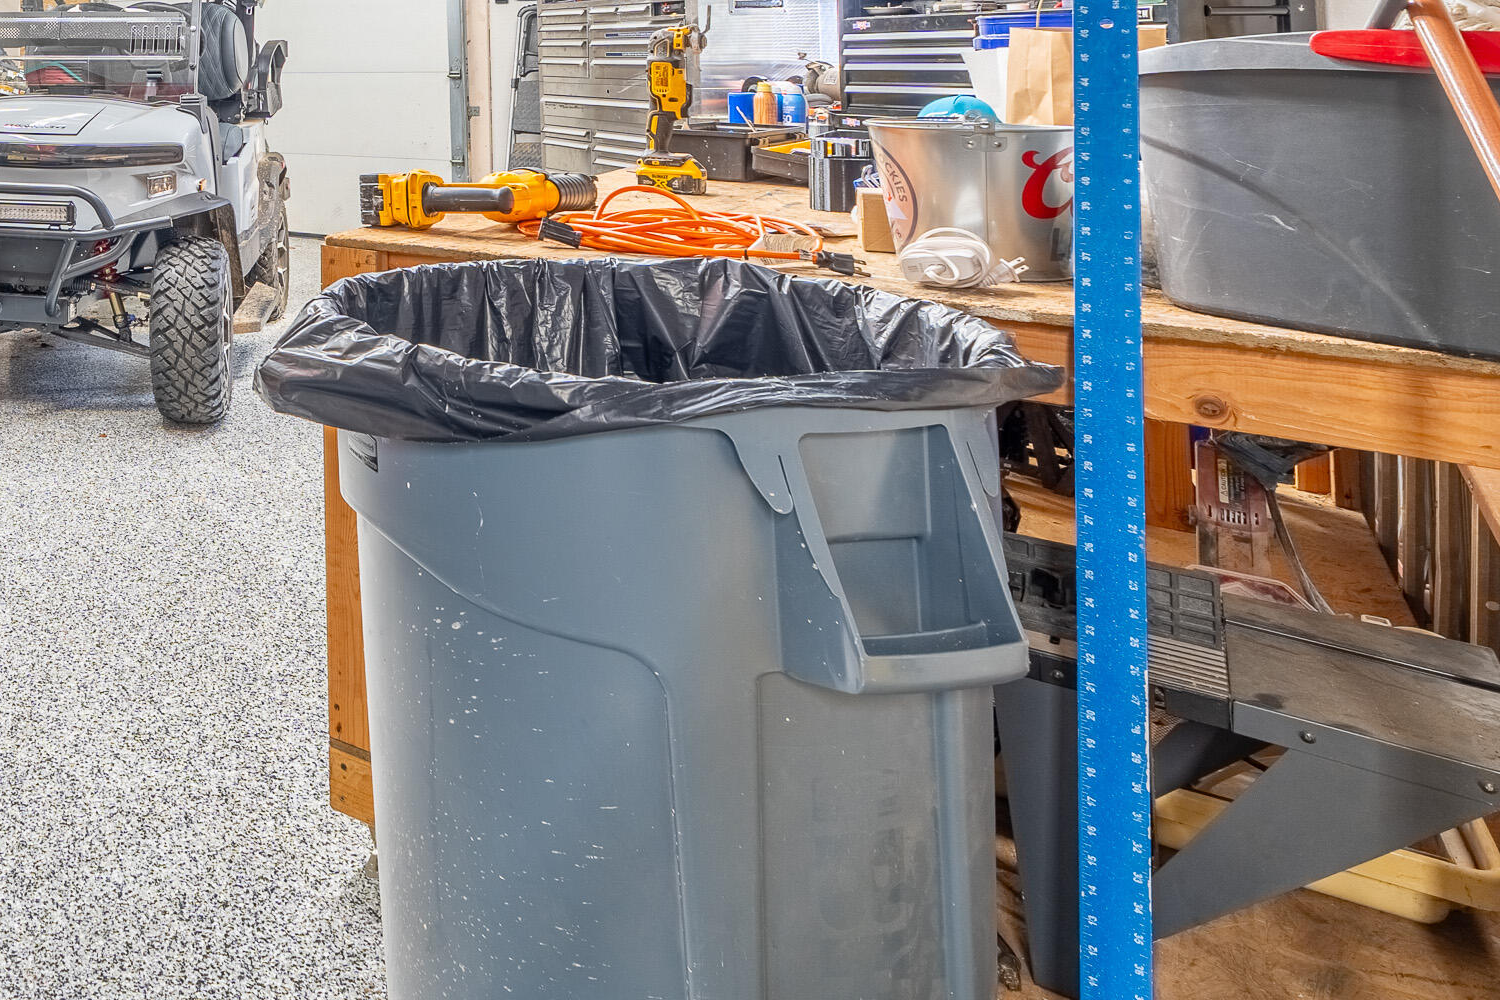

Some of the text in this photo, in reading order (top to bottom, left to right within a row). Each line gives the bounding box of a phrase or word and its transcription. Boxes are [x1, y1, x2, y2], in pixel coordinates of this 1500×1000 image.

[877, 152, 908, 203] OCKIES
[1080, 6, 1098, 987] 11 12 13 14 15 16 17 18 19 20 21 22 23 24 25 26 27 28 29 30 31 32 33 34 35 36 37 38 39 40 41 42 43 44 45 46 47
